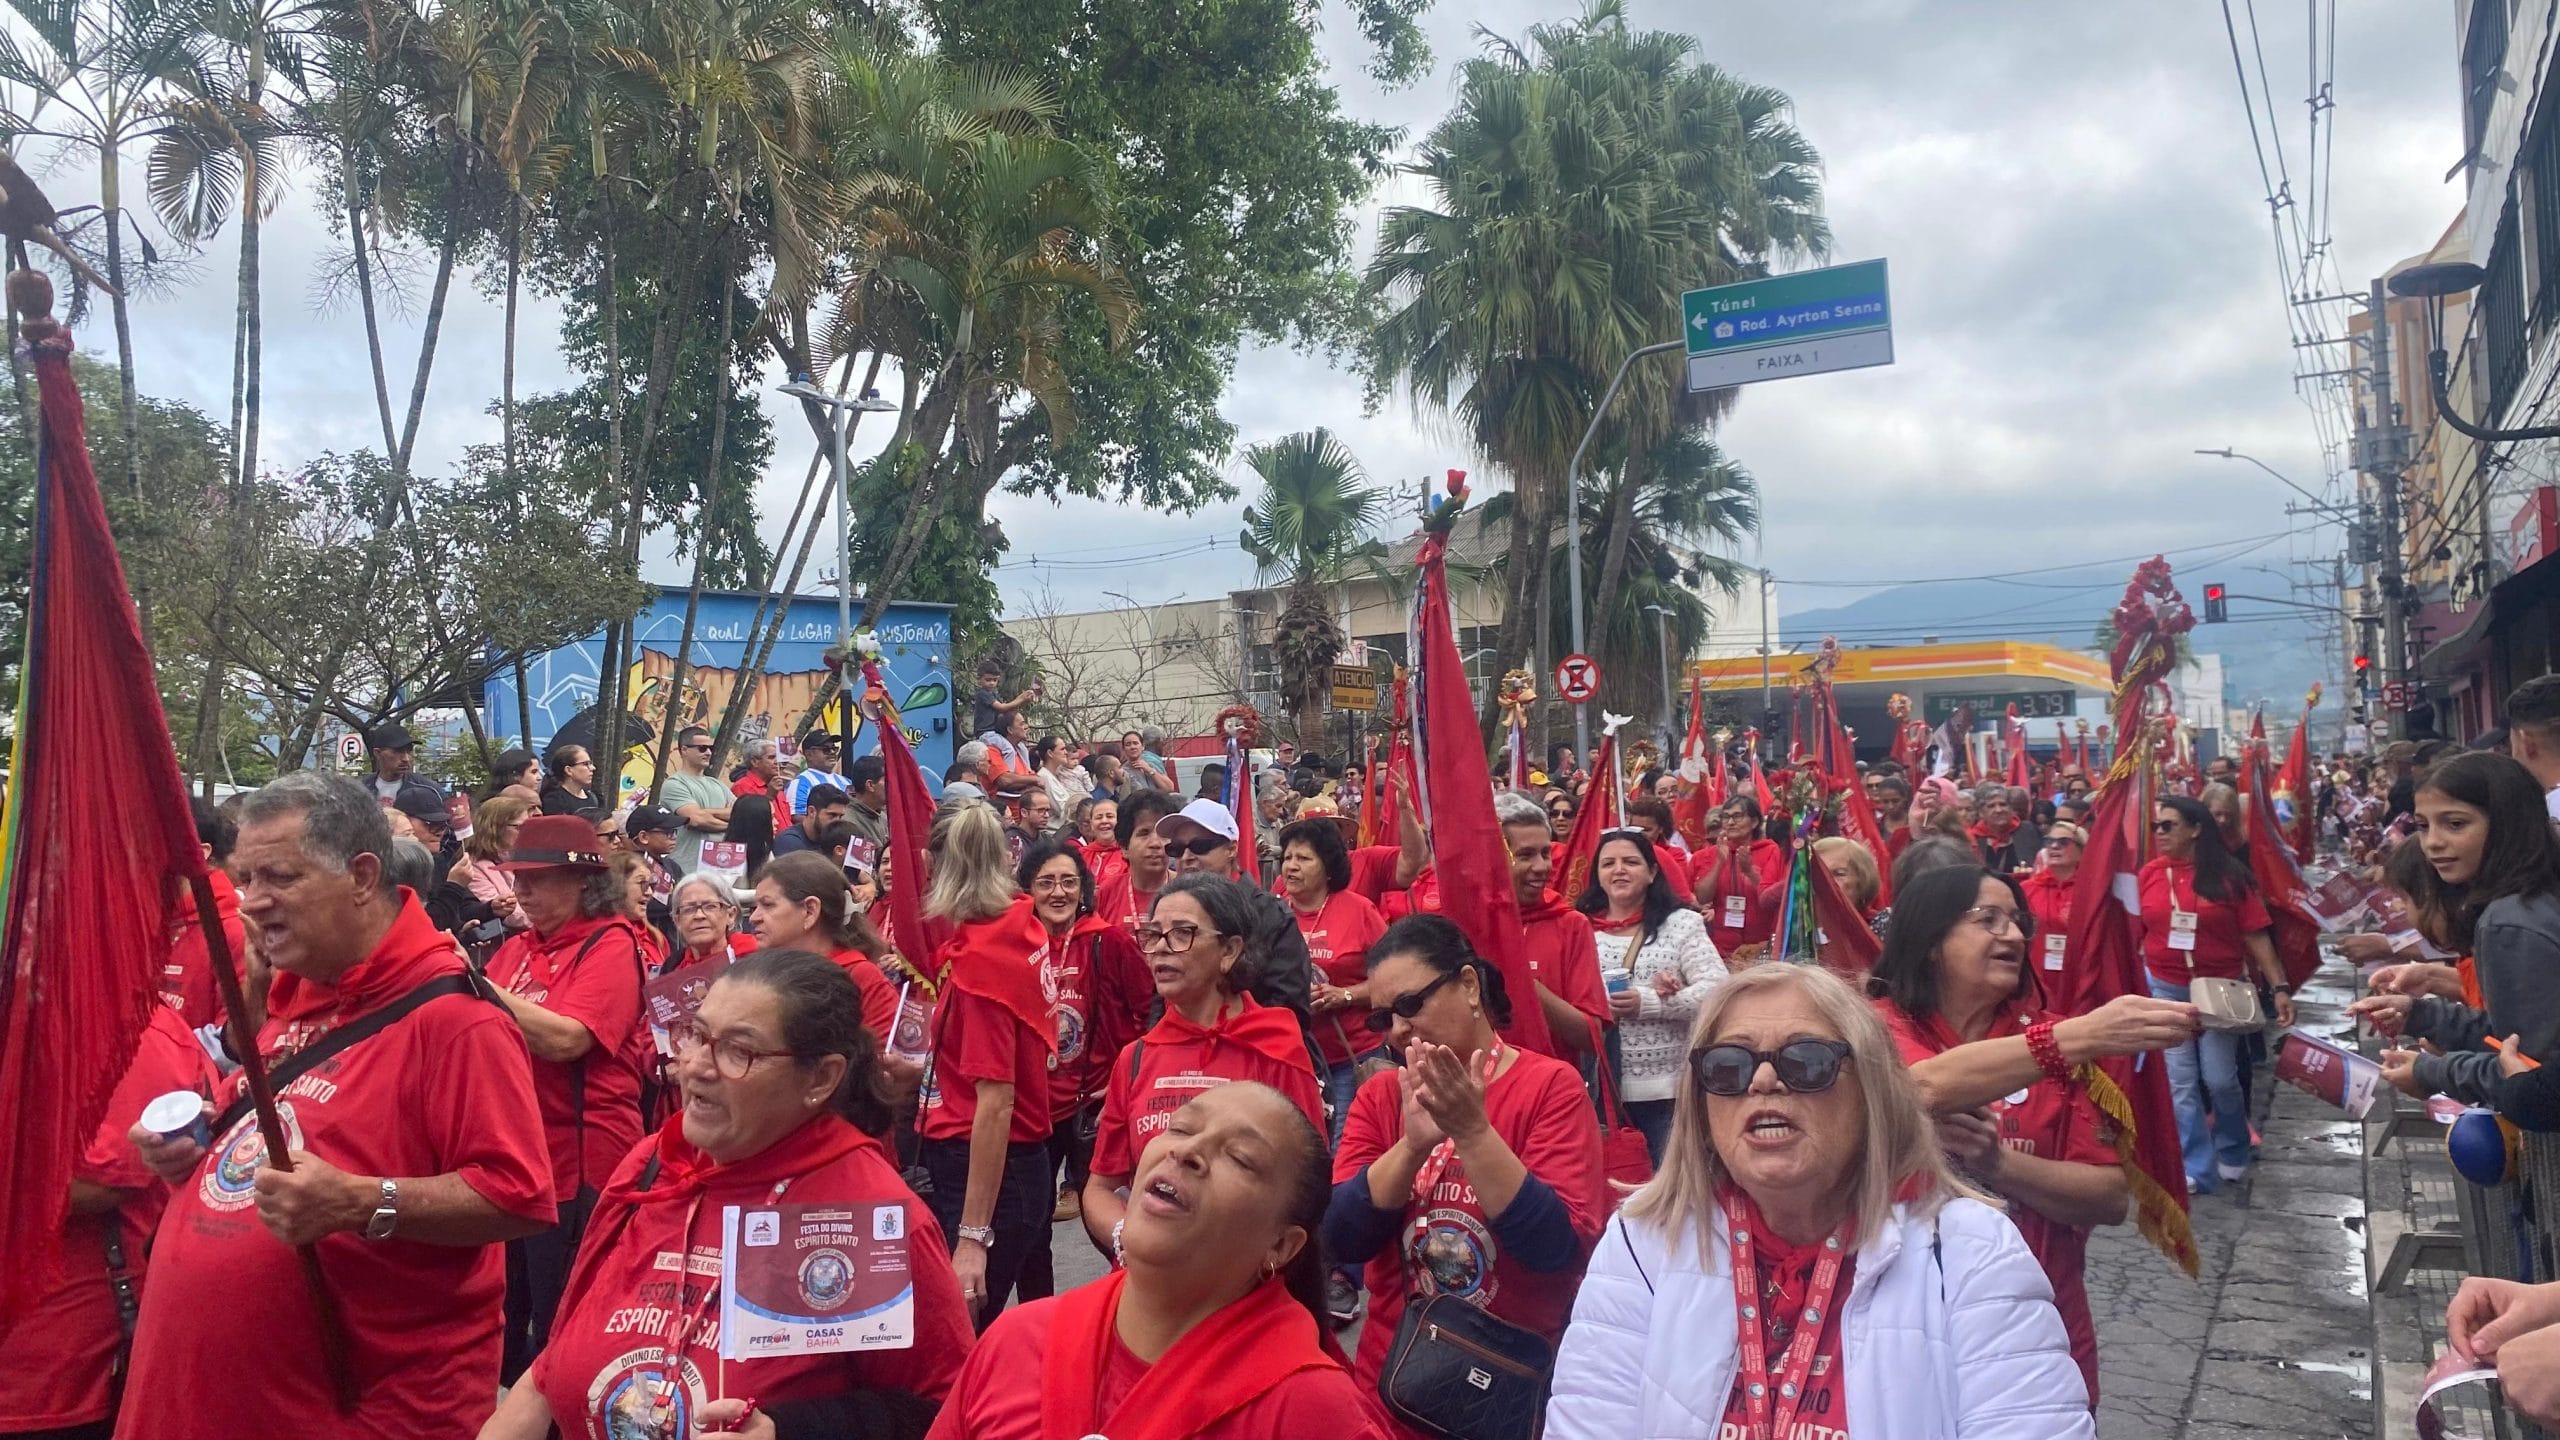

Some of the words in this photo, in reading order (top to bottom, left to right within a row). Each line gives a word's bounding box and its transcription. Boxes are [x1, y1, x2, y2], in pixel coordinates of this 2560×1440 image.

[1711, 296, 1756, 313] Túnel
[1740, 317, 1772, 332] Rod.
[1776, 309, 1830, 328] Ayrton
[1834, 301, 1882, 318] Senna
[1757, 352, 1803, 370] FAIXA
[1813, 350, 1820, 363] 1
[790, 622, 832, 641] LUGAR
[1136, 1109, 1171, 1136] ESPÍR
[2001, 1137, 2036, 1155] NTO
[800, 1224, 820, 1236] FESTA
[820, 1223, 830, 1233] DO
[830, 1223, 853, 1234] DIVINO
[831, 1233, 859, 1247] SANTO
[806, 1327, 844, 1338] CASAS
[806, 1337, 840, 1348] BAHIA
[620, 1350, 649, 1369] DIVINO
